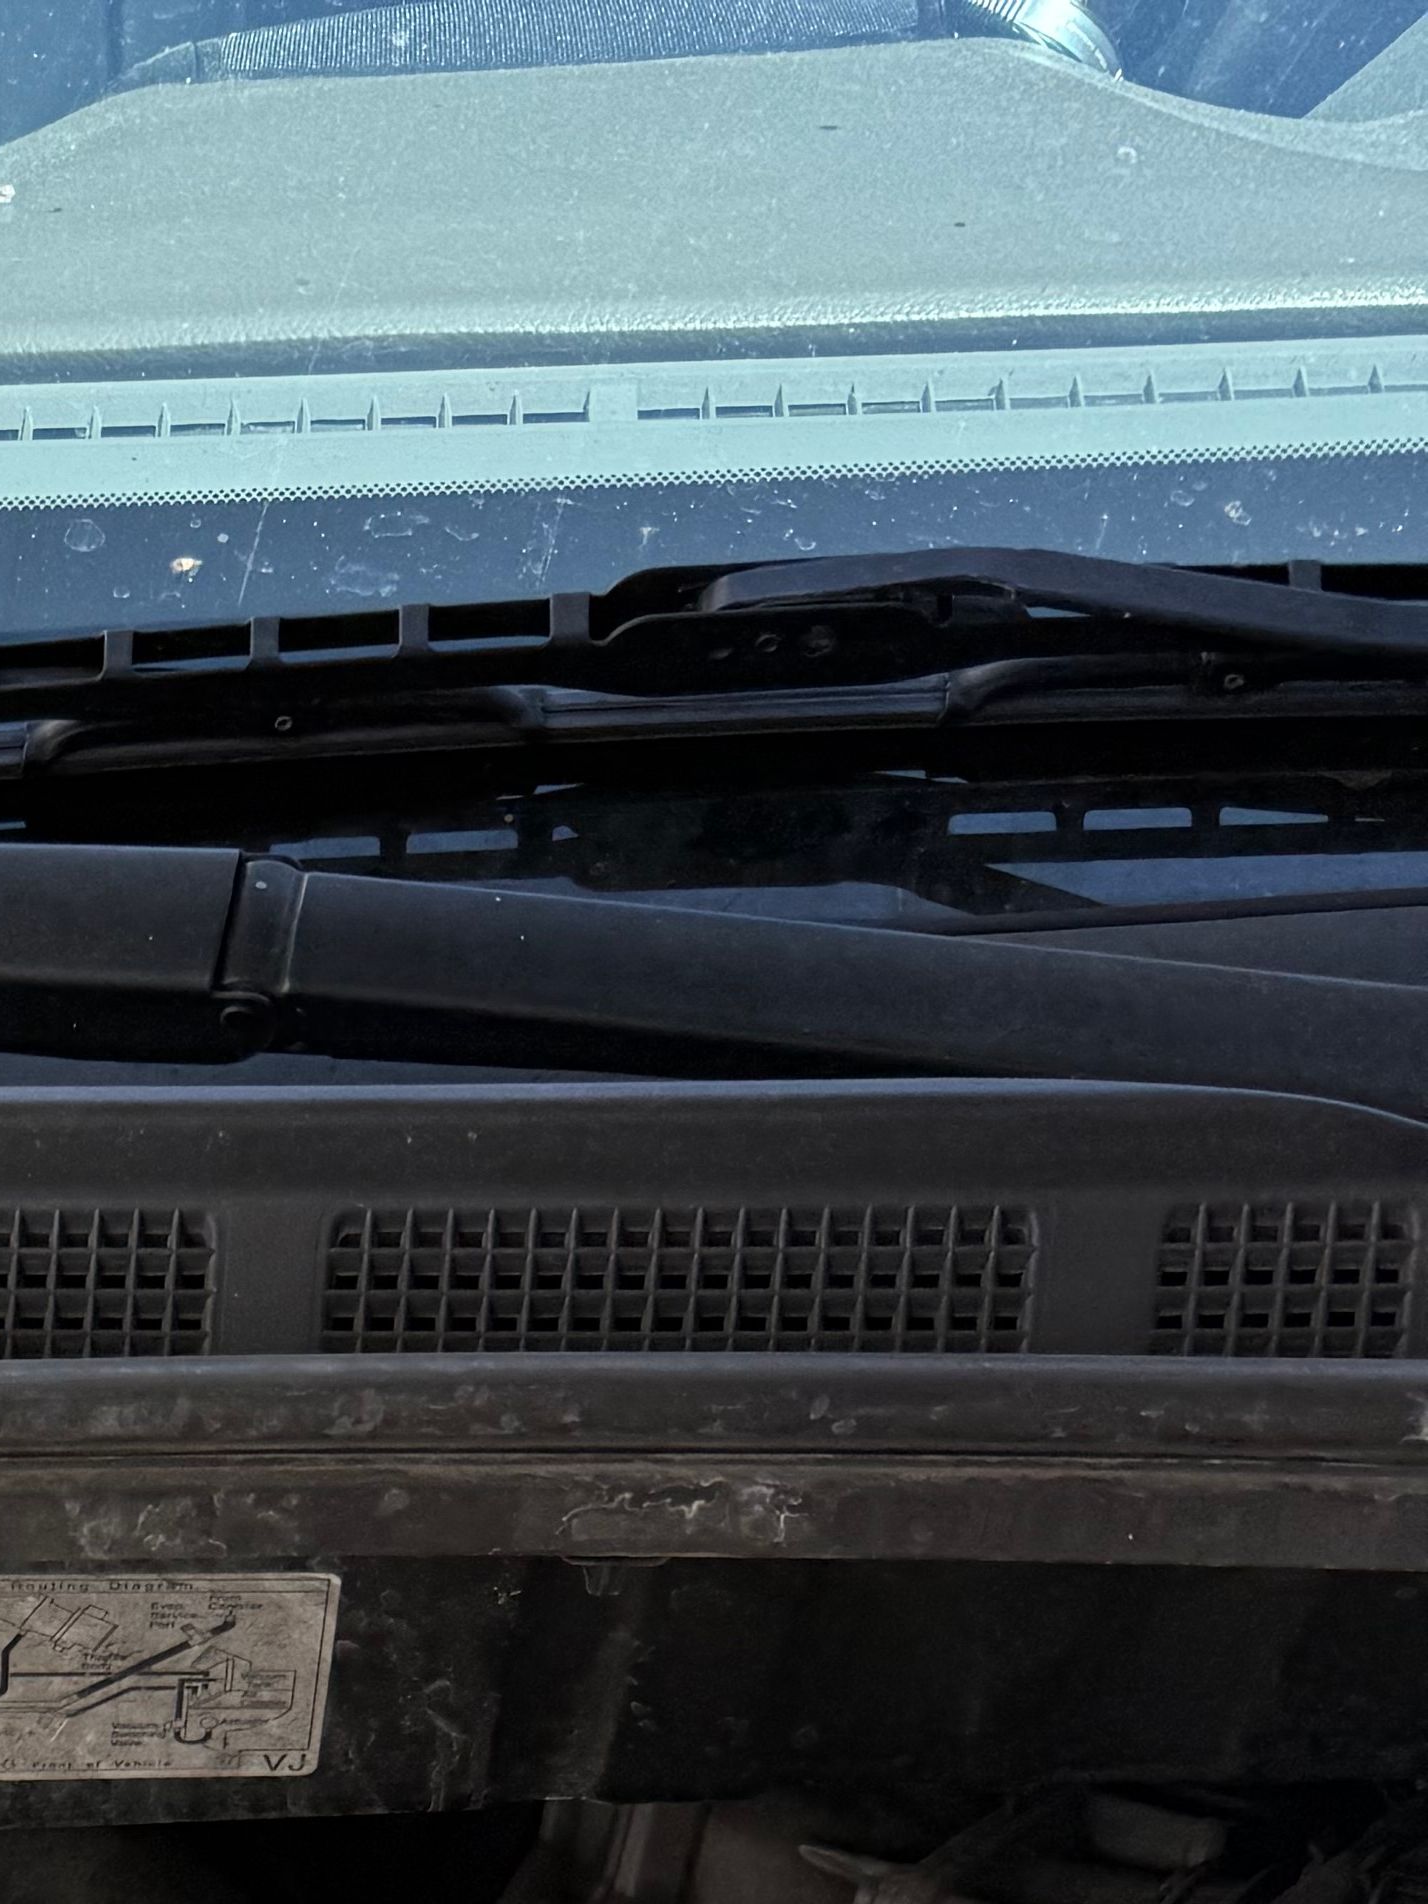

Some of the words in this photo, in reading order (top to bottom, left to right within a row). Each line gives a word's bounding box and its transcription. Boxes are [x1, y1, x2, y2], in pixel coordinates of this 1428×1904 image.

[10, 1581, 90, 1592] Routing
[108, 1581, 195, 1593] Diagram
[114, 1758, 172, 1769] Vehicle
[263, 1753, 307, 1771] VJ
